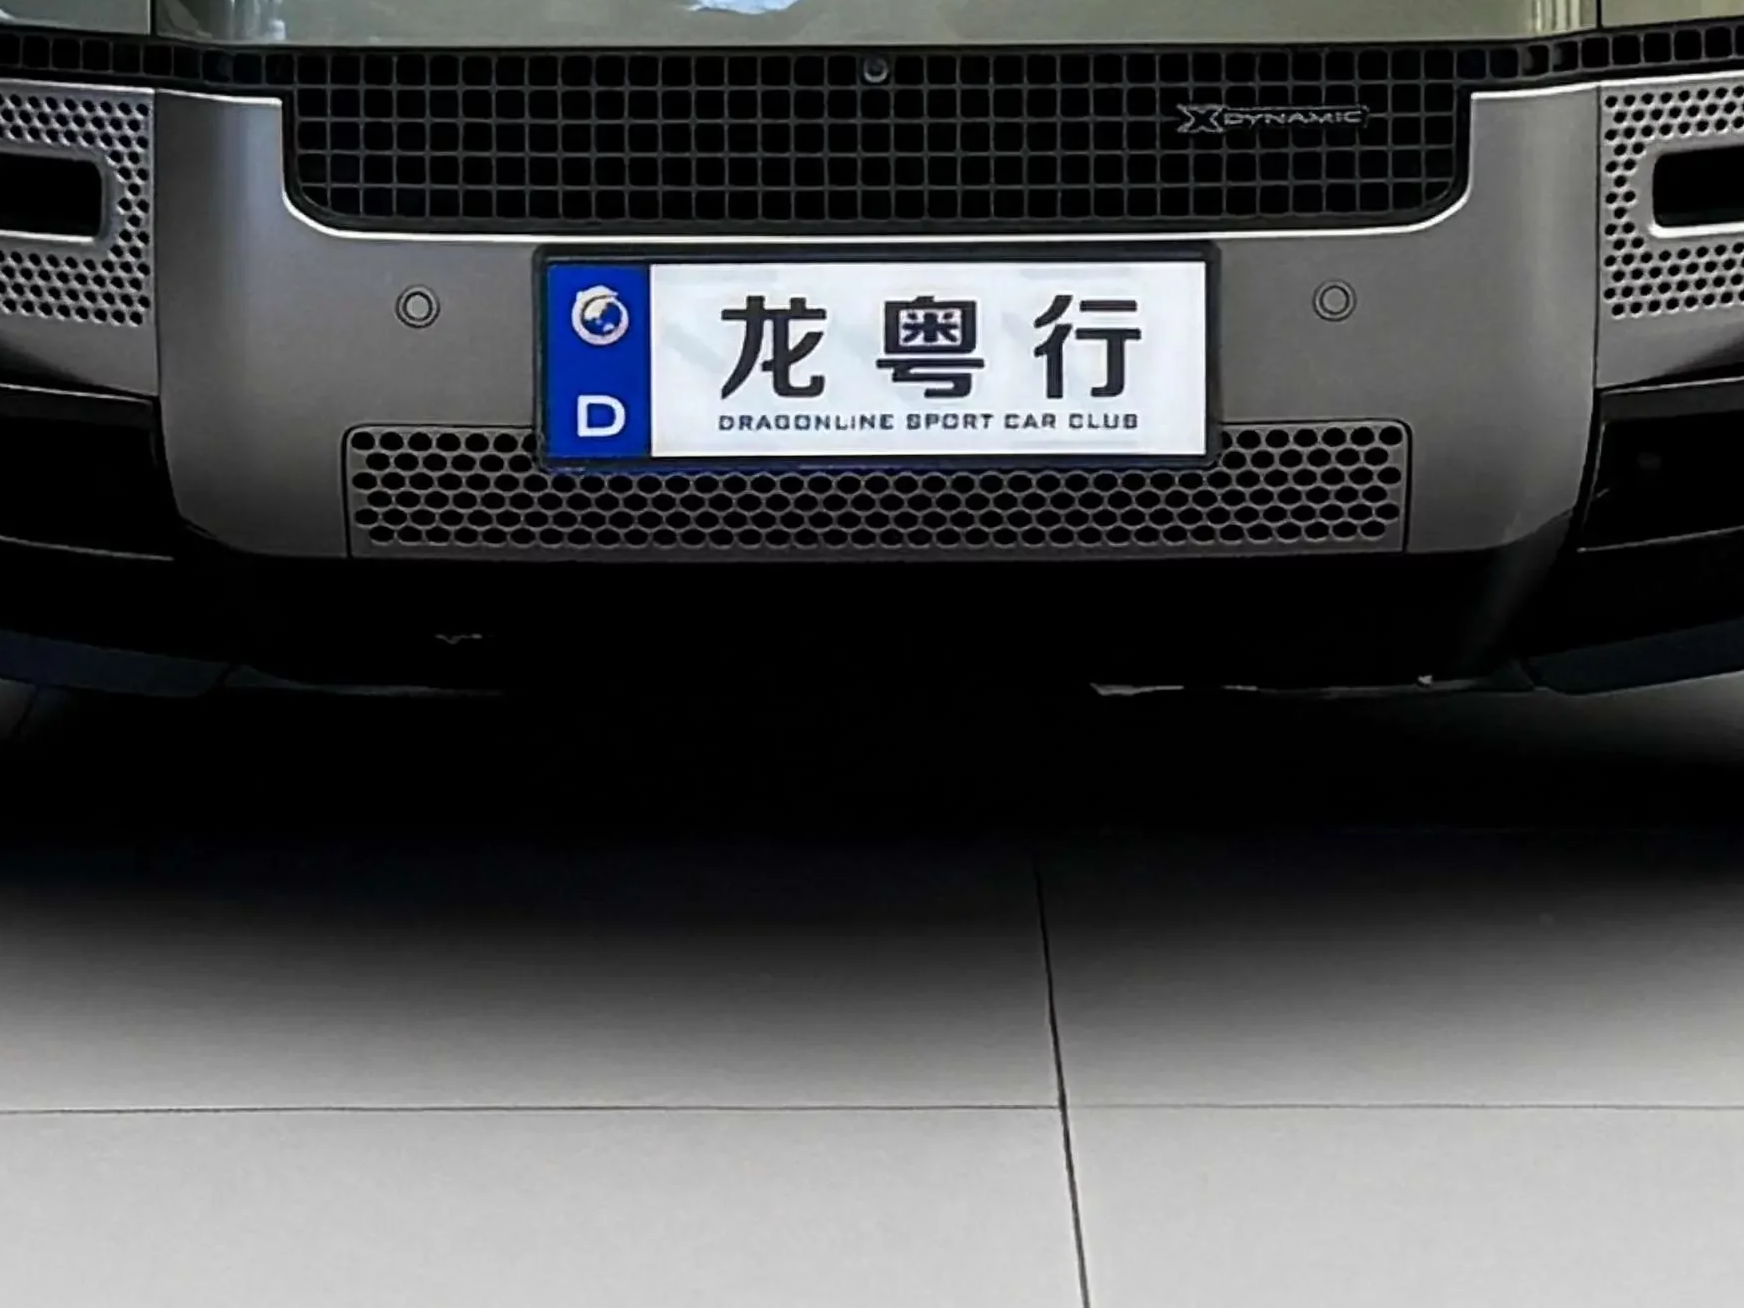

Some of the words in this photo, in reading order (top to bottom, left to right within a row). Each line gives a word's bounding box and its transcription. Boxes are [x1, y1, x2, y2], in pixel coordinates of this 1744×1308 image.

[719, 294, 1143, 400] 龙粤行
[575, 395, 628, 438] D
[717, 413, 895, 432] DRAGONLINE
[905, 412, 994, 431] SPORT
[1004, 412, 1057, 430] CAR
[1067, 412, 1140, 430] CLUB
